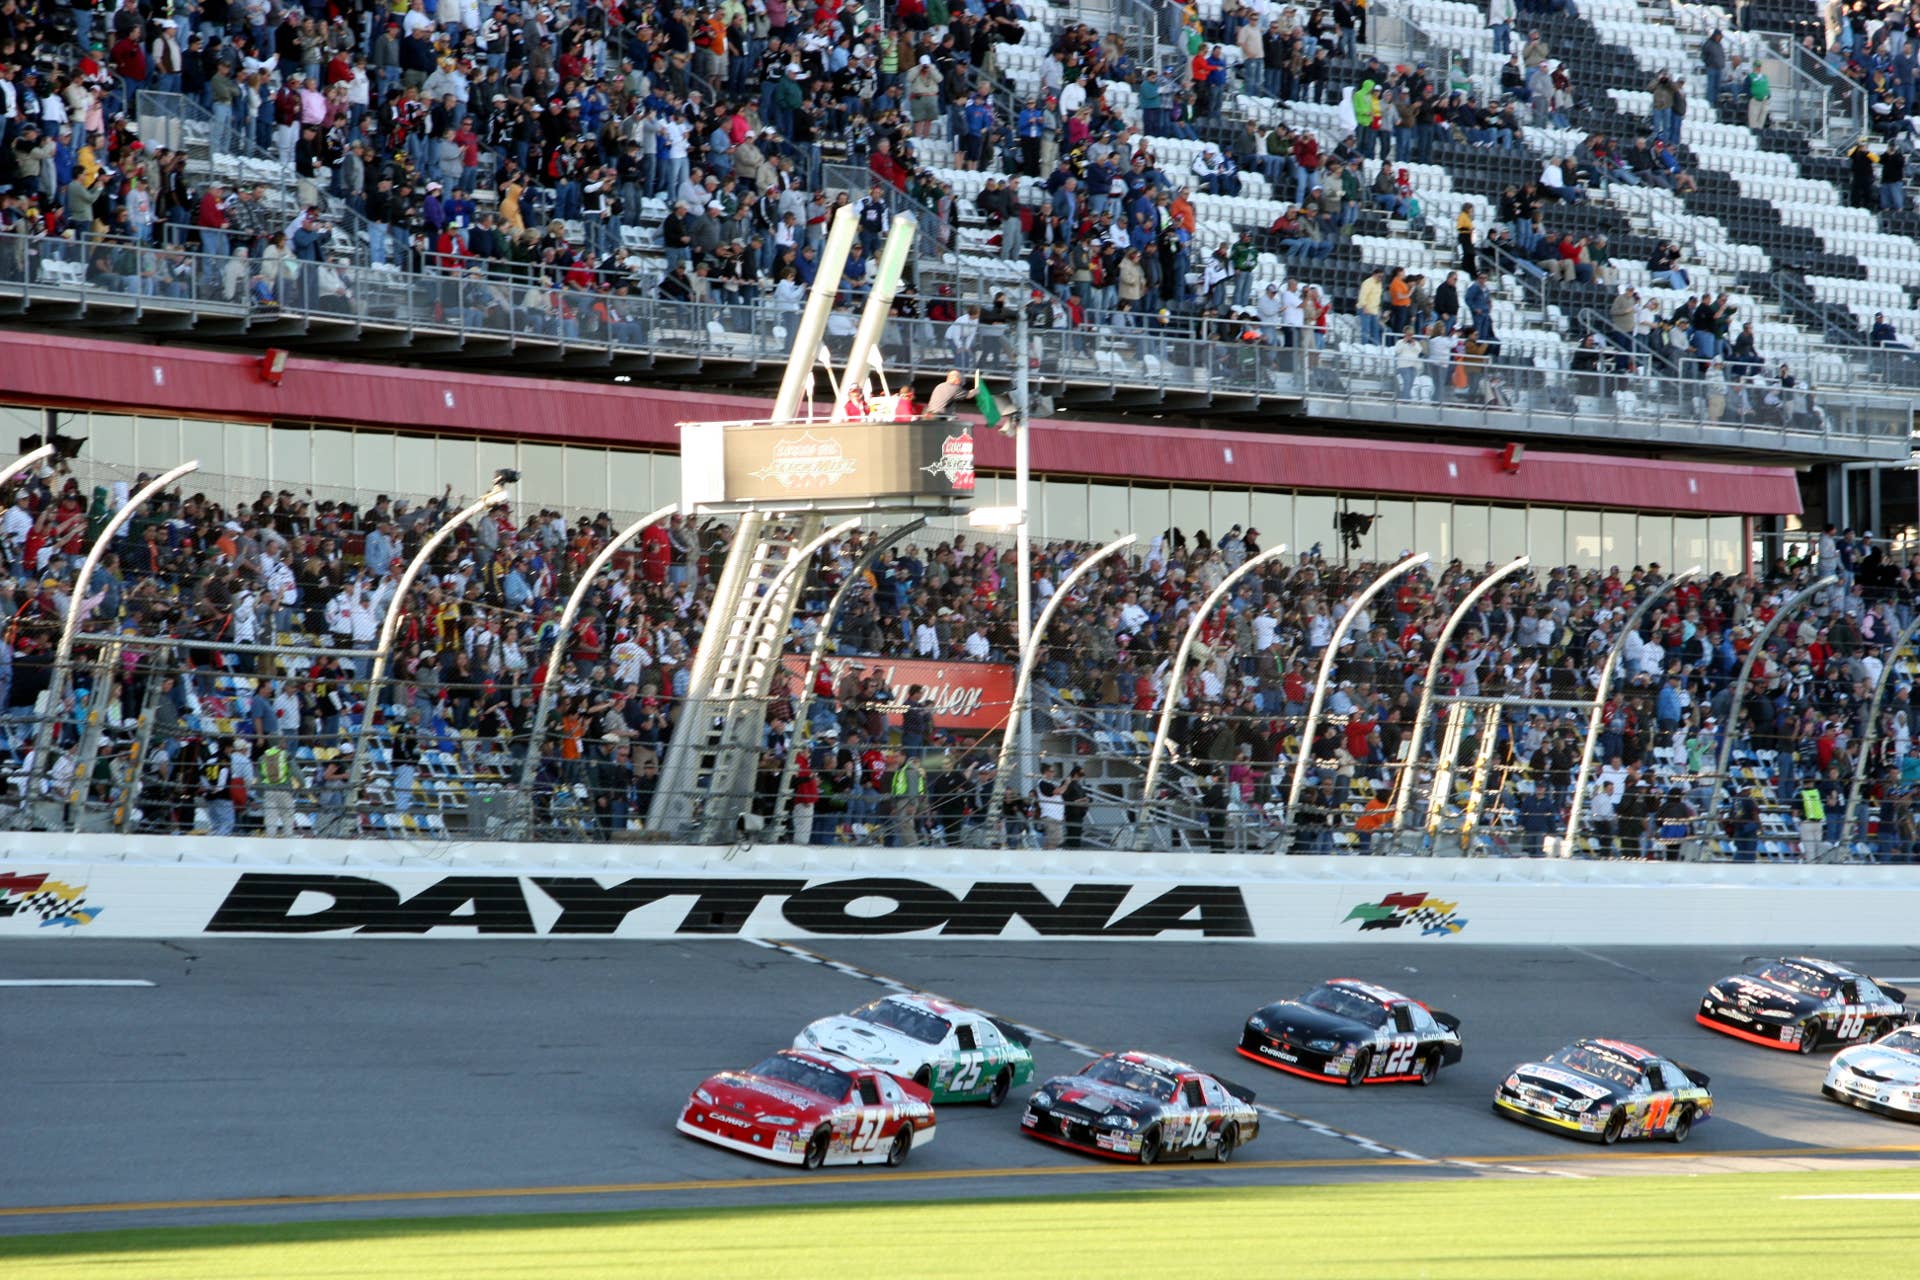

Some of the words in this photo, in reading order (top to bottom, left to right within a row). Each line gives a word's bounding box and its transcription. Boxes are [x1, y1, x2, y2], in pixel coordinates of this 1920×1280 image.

[204, 873, 1256, 938] DAYTONA
[1837, 1005, 1867, 1038] 66
[950, 1052, 984, 1091] 25
[1259, 1045, 1298, 1063] CHARGER
[1385, 1036, 1417, 1074] 22
[708, 1111, 753, 1129] CAMRY
[1182, 1110, 1210, 1147] 16
